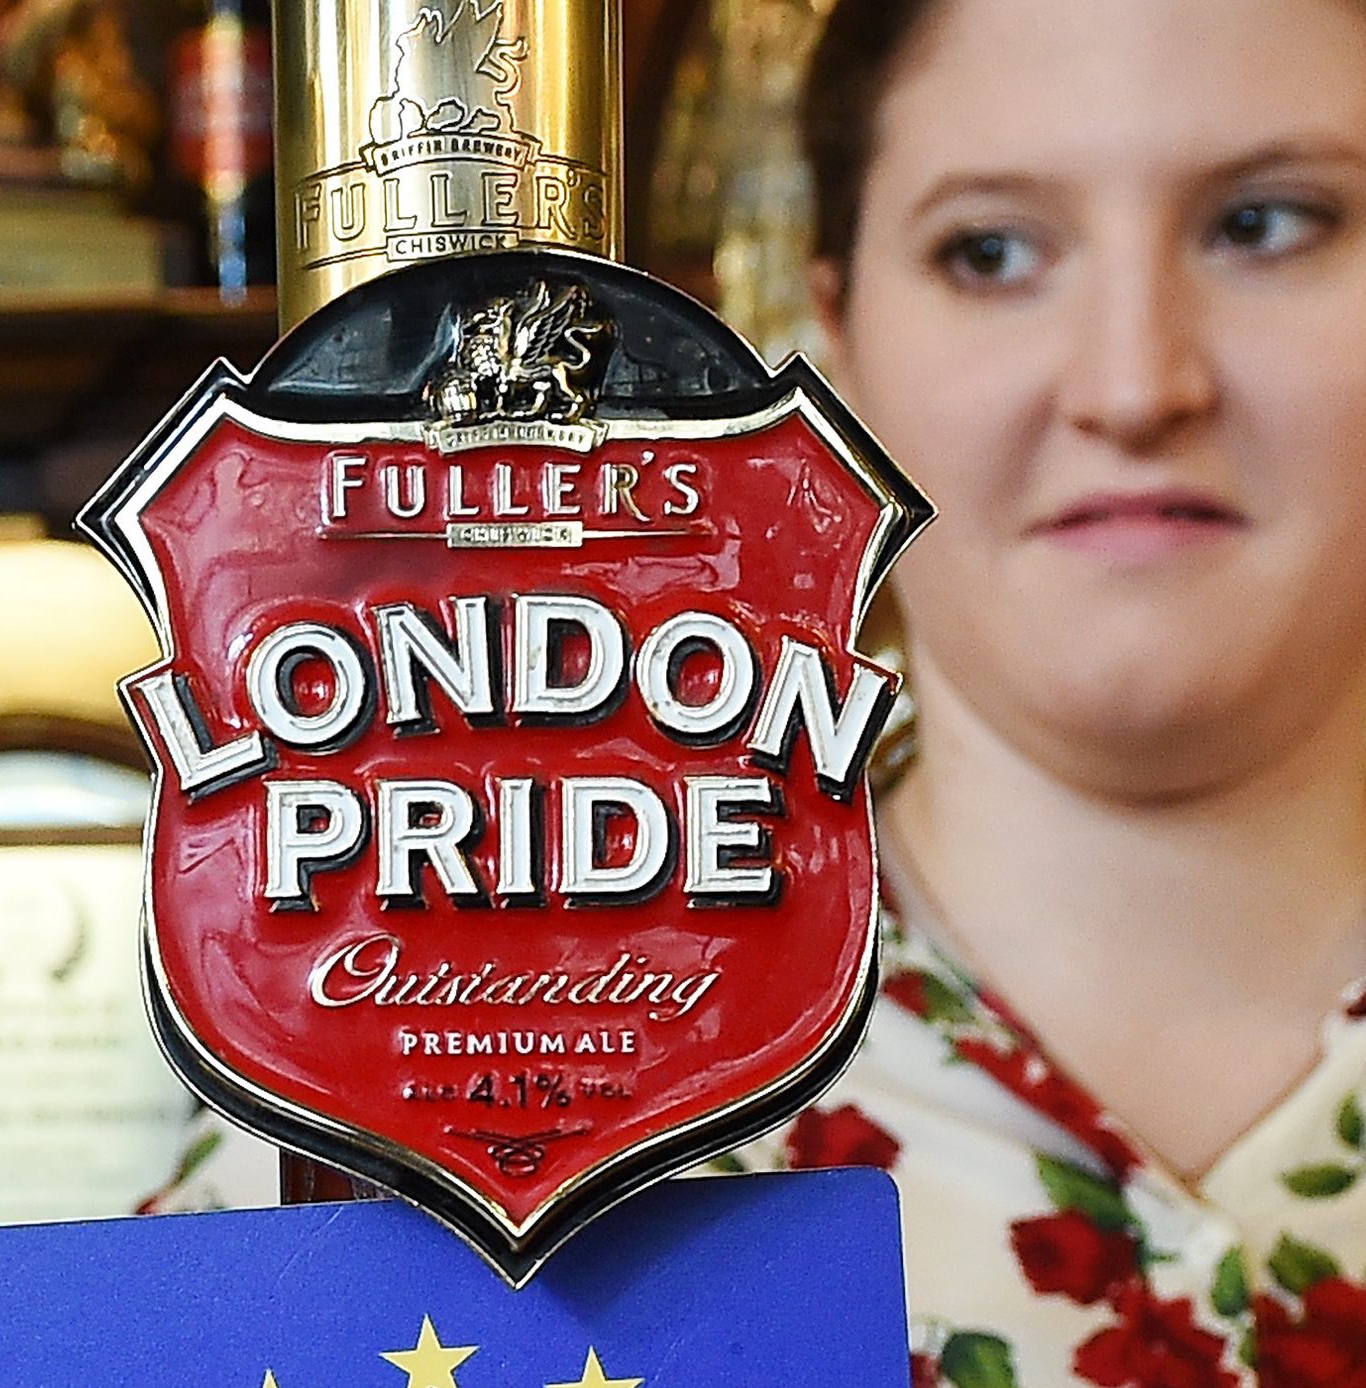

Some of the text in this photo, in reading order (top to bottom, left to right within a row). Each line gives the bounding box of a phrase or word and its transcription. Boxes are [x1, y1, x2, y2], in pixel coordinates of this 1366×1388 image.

[381, 137, 524, 167] GRIFFIN BREWERY
[295, 169, 606, 250] FULLER'S
[395, 235, 507, 255] CHISWICK
[330, 450, 699, 522] FULLER'S
[135, 594, 893, 800] LONDON
[264, 776, 780, 910] PRIDE
[308, 932, 724, 1022] Outstanding
[401, 1030, 636, 1056] PREMIUM ALE
[467, 1073, 572, 1109] 4.1%
